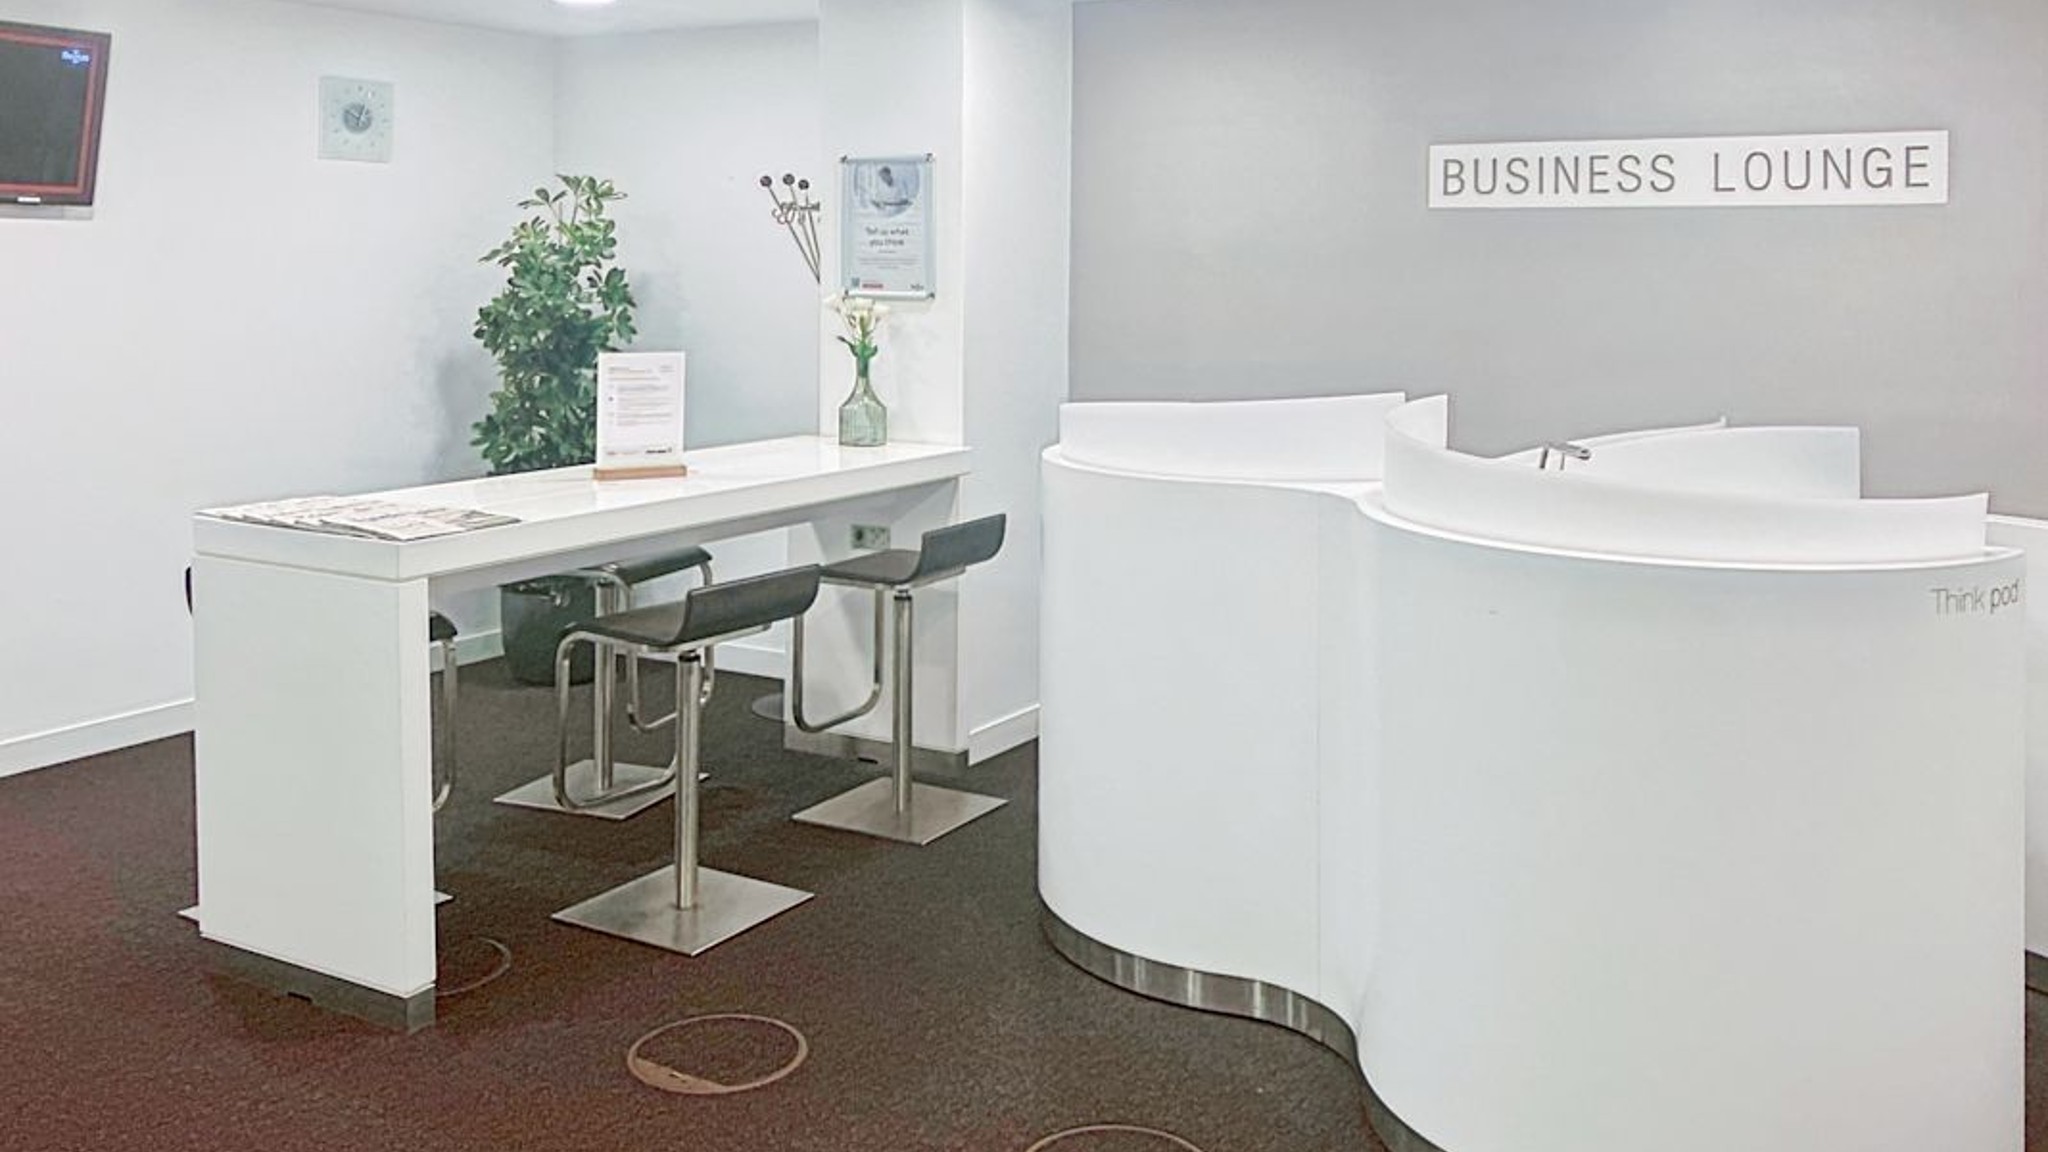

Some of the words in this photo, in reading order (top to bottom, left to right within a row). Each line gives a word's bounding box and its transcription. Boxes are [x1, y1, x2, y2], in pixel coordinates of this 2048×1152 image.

[1442, 153, 1676, 196] BUSINESS
[1713, 145, 1931, 193] LOUNGE
[1930, 586, 1985, 615] Think
[1989, 578, 2020, 614] pod
